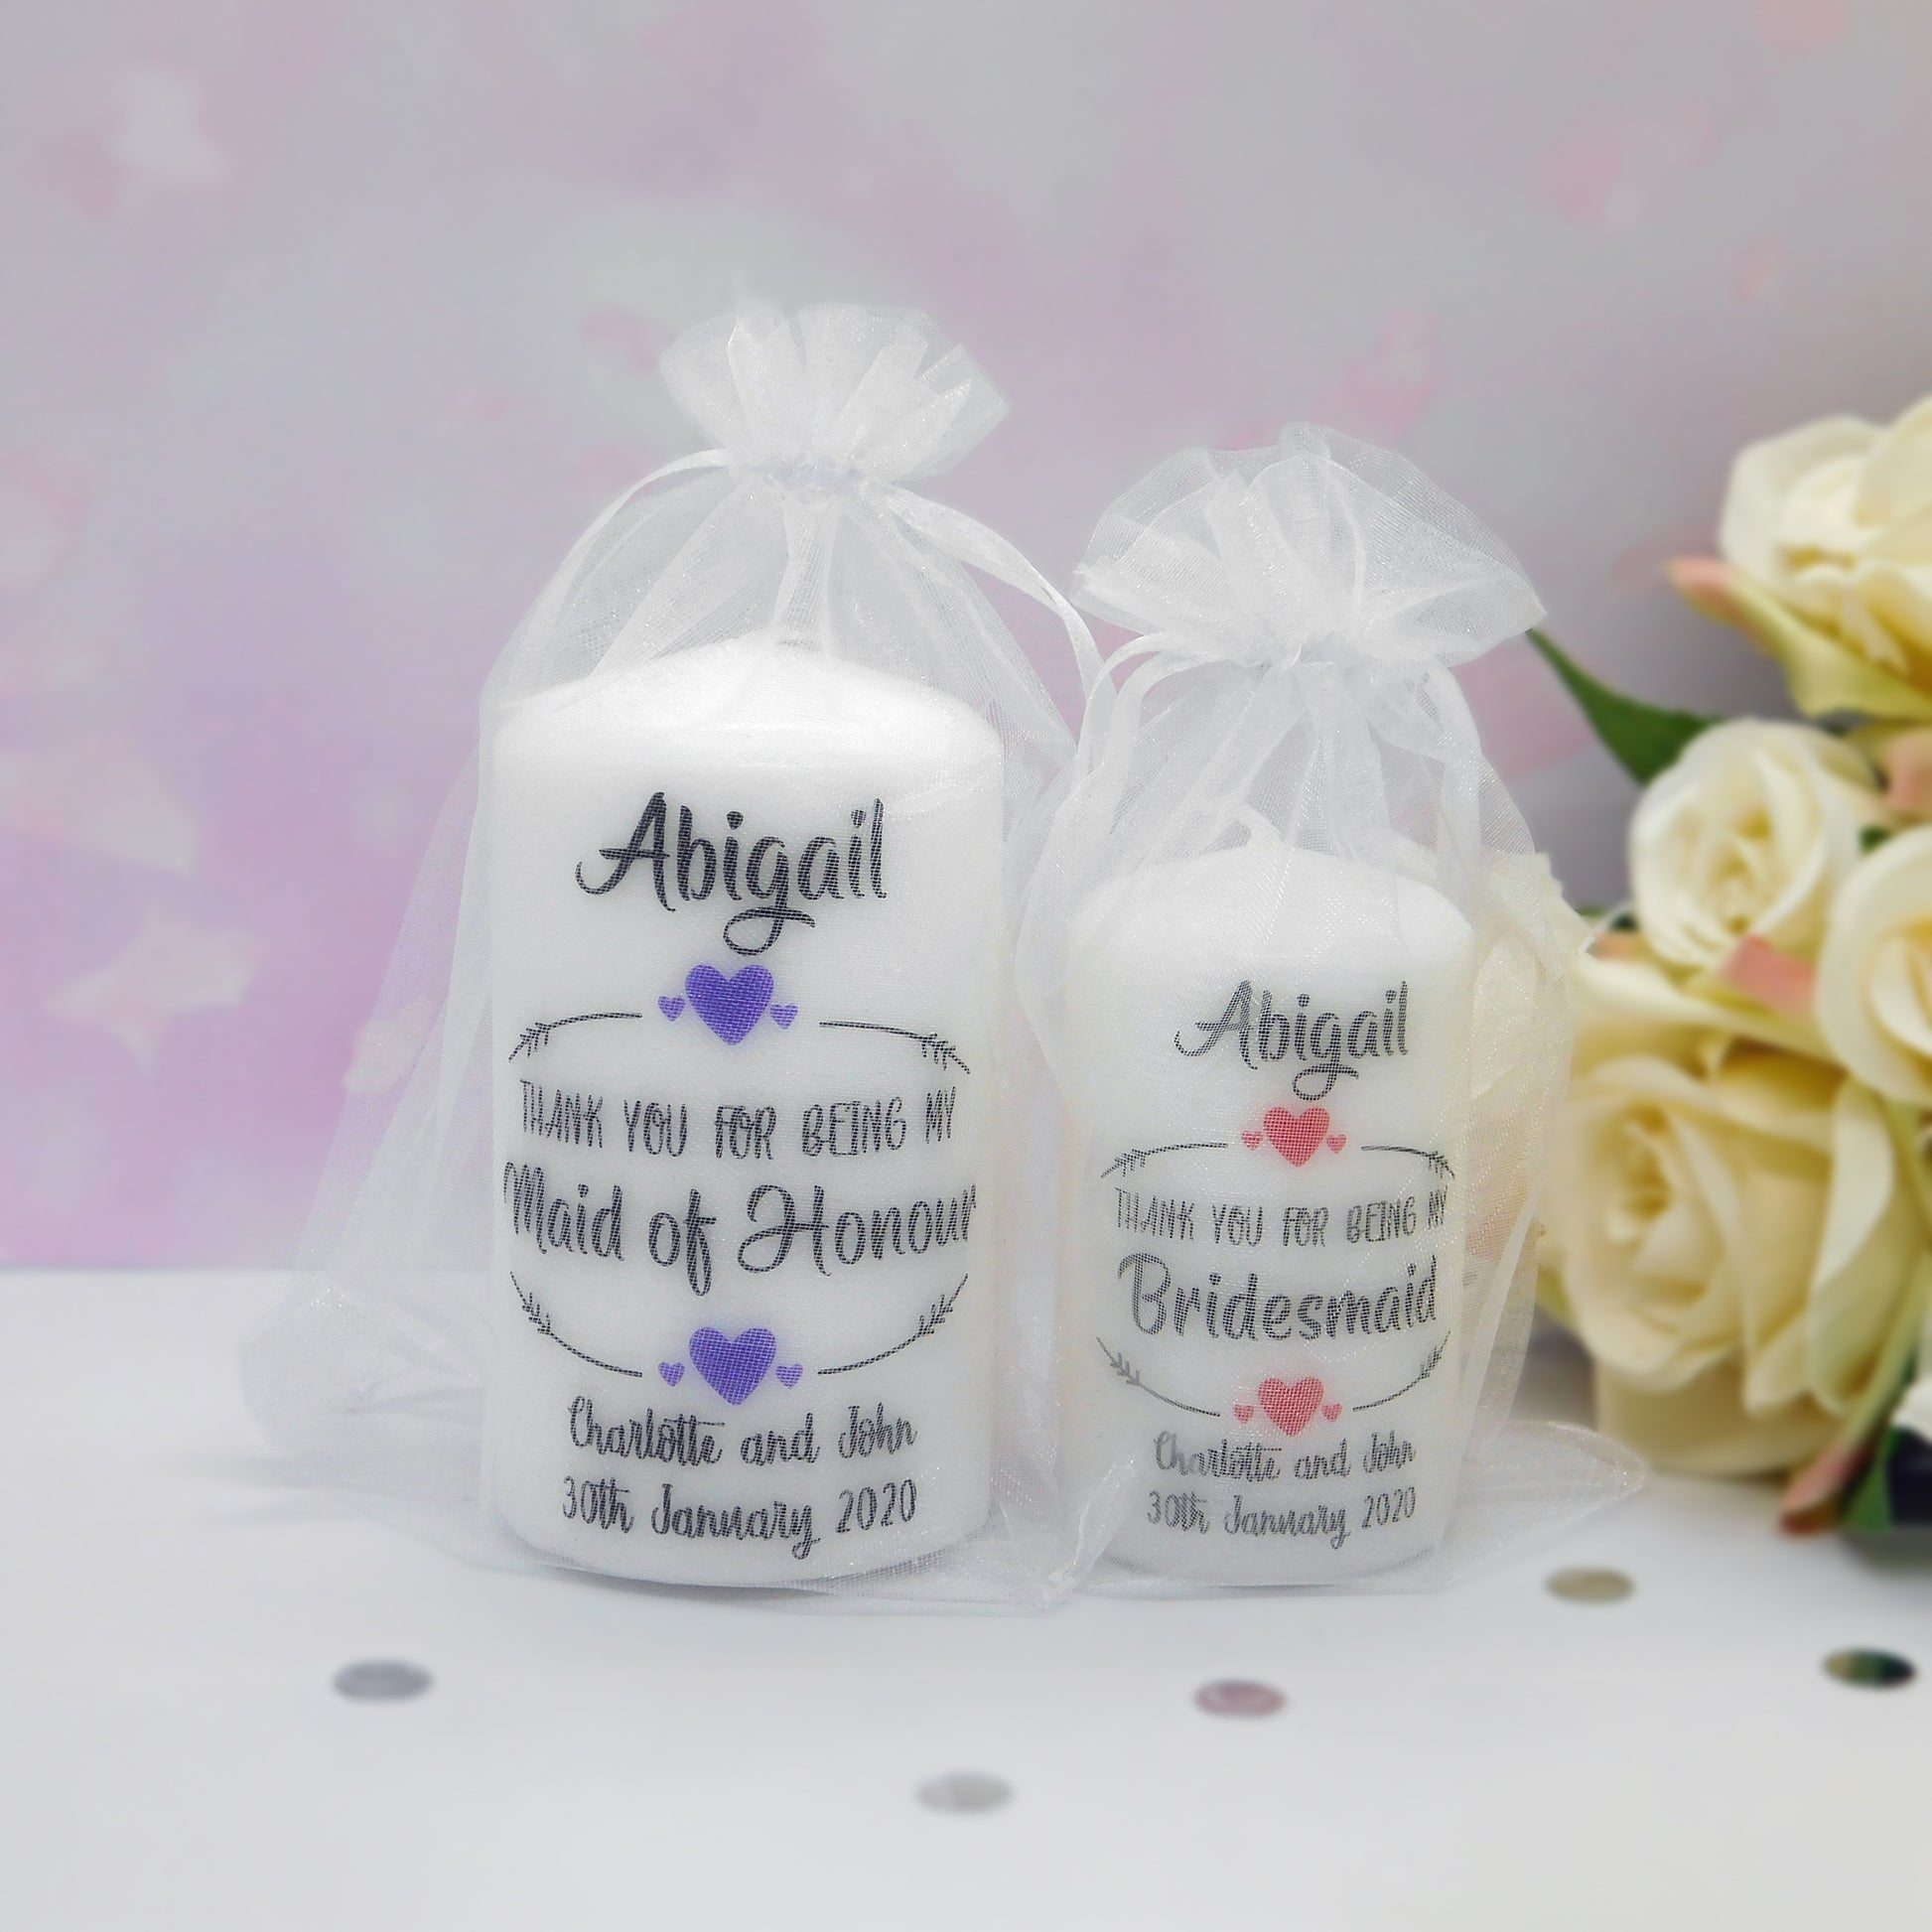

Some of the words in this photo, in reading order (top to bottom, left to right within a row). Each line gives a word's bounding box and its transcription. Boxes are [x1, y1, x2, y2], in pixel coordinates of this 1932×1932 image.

[576, 791, 887, 956] Abigail
[1173, 980, 1408, 1101] Abigail
[519, 1079, 603, 1148] THANK
[623, 1099, 687, 1157] YOU
[715, 1105, 776, 1160] FOR
[802, 1096, 907, 1157] BEING
[925, 1086, 955, 1144] MY
[502, 1162, 624, 1262] Maid
[648, 1188, 717, 1296] of
[737, 1183, 977, 1276] Honour
[1115, 1186, 1195, 1241] THANK
[1212, 1203, 1263, 1247] YOU
[1282, 1206, 1329, 1247] FOR
[1345, 1195, 1417, 1243] BEING
[1427, 1184, 1449, 1230] MY
[1118, 1252, 1437, 1341] Bridesmaid
[568, 1395, 725, 1466] Charlotte
[741, 1412, 820, 1464] and
[838, 1402, 917, 1458] John
[1154, 1431, 1282, 1482] Charlotte
[1295, 1439, 1352, 1479] and
[1362, 1431, 1417, 1473] John
[562, 1475, 633, 1534] 30th
[651, 1483, 820, 1560] January
[836, 1479, 917, 1534] 2020
[1147, 1490, 1212, 1535] 30th
[1224, 1494, 1351, 1550] January
[1361, 1486, 1417, 1530] 2020
